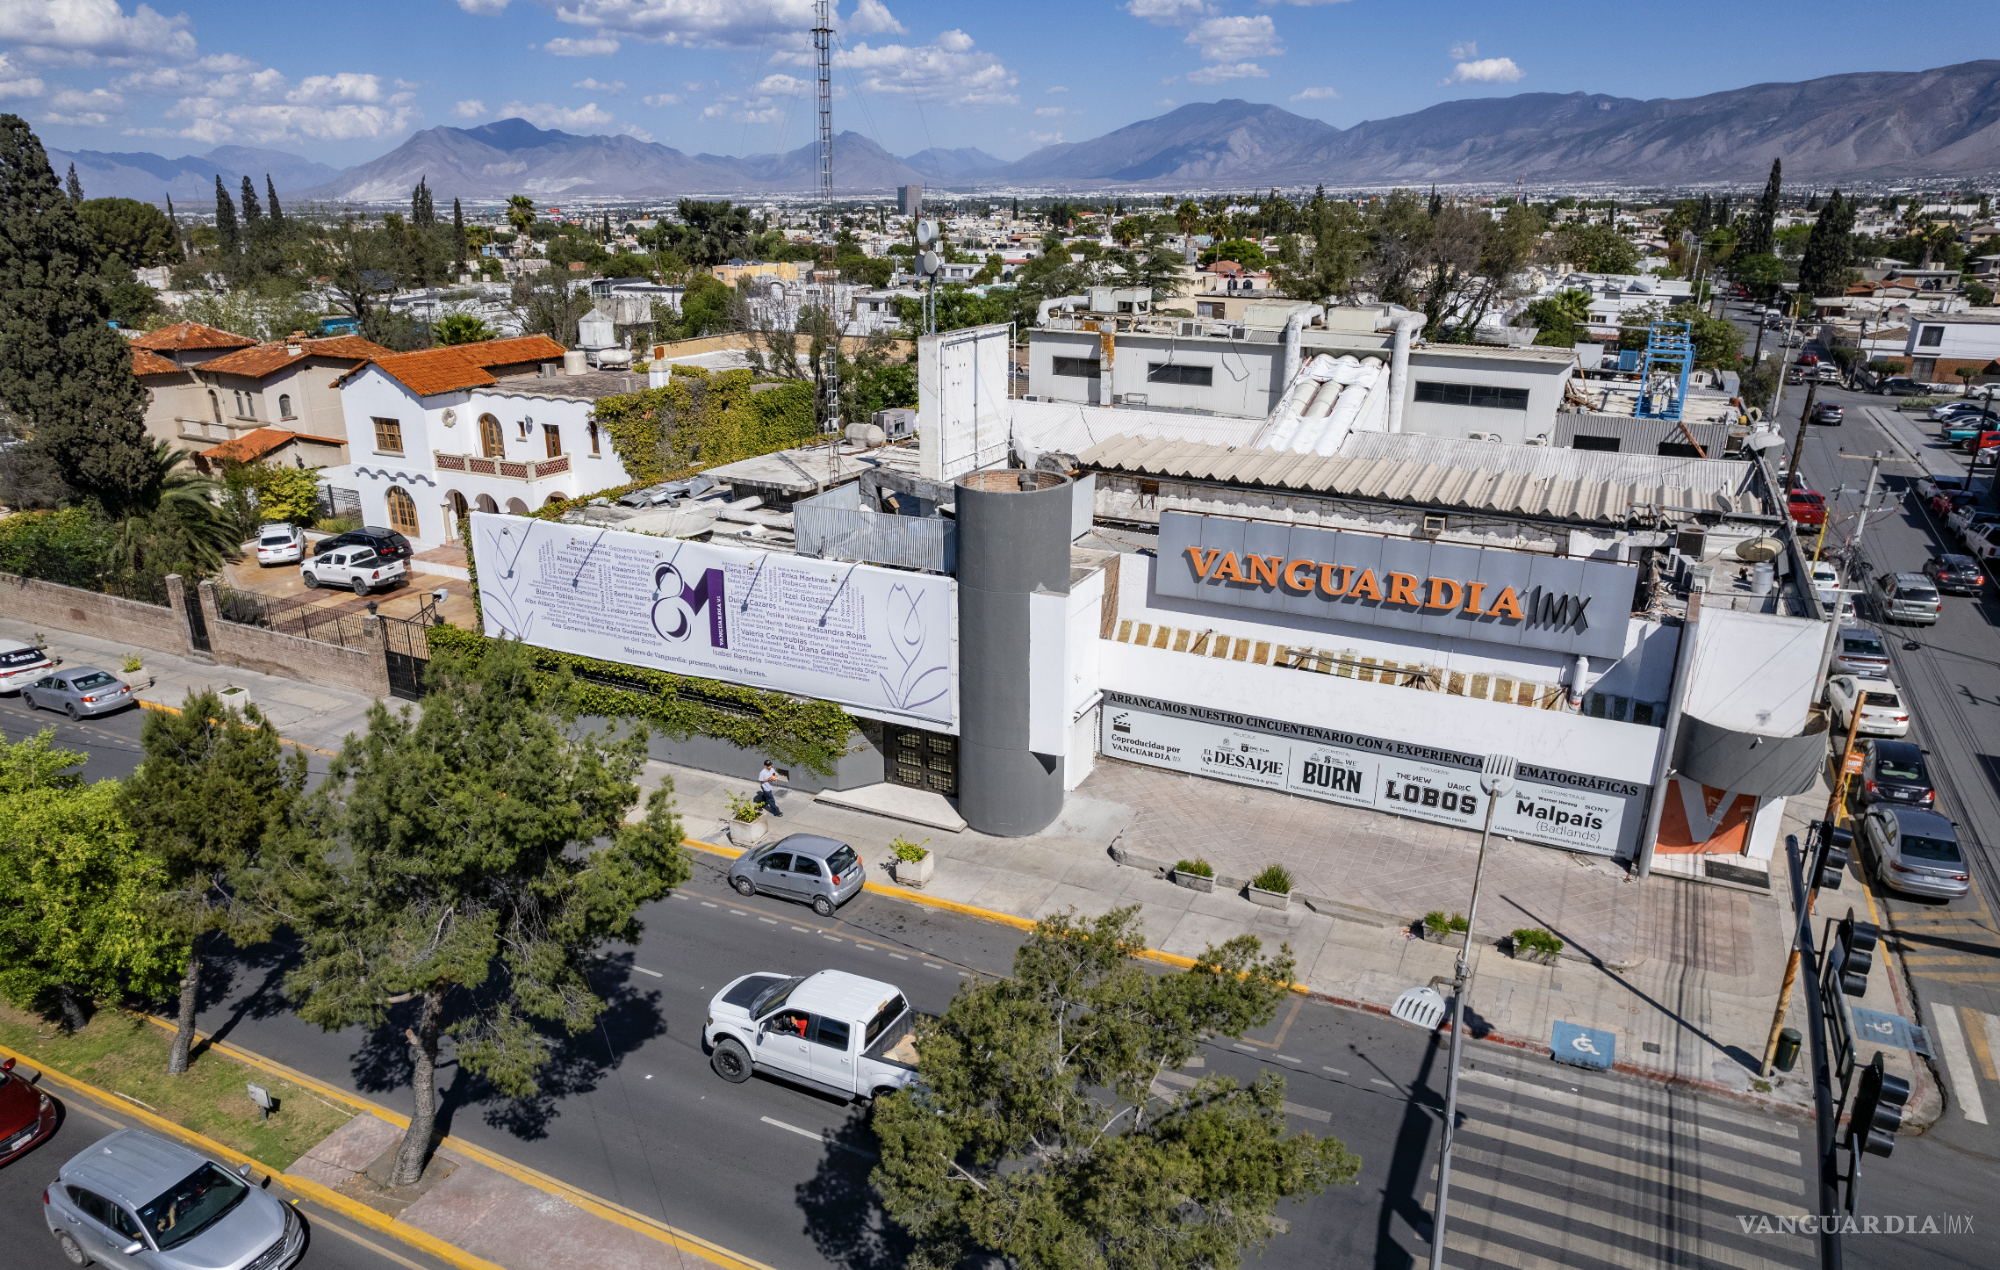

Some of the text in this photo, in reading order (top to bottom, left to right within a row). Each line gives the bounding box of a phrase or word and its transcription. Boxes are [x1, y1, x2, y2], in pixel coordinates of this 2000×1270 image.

[783, 580, 806, 588] Rebeca
[800, 575, 828, 584] Martínez
[1185, 545, 1525, 620] VANGUARDIA
[536, 588, 555, 597] Blanca
[634, 594, 651, 602] Ibarra
[783, 592, 798, 600] Itzel
[630, 610, 650, 619] Portillo
[741, 628, 764, 638] Valeria
[807, 625, 844, 636] Kassandra
[846, 631, 866, 640] Rojas
[713, 649, 732, 658] Isabel
[798, 644, 818, 654] Diana
[821, 649, 848, 659] Galindo
[654, 651, 688, 663] Vanguardia:
[689, 659, 718, 669] presentes,
[719, 664, 738, 673] unidas
[744, 668, 767, 678] fuertes.
[1109, 692, 1187, 715] ARRANCAMOS
[1189, 707, 1244, 725] NUESTRO
[1246, 717, 1353, 744] CINCUENTENARIO
[1356, 737, 1383, 749] CON
[1385, 742, 1393, 752] 4
[1396, 743, 1484, 768] EXPERIENCIA
[1111, 734, 1164, 750] Coproducidas
[1111, 743, 1170, 761] VANGUARDIA
[1214, 751, 1283, 775] DESAIRE
[1302, 761, 1363, 794] BURN
[1396, 772, 1411, 780] THE
[1384, 779, 1478, 816] LOBOS
[1516, 800, 1603, 830] Malpaís
[1584, 804, 1610, 813] SONY
[1535, 820, 1601, 843] (Badlands)
